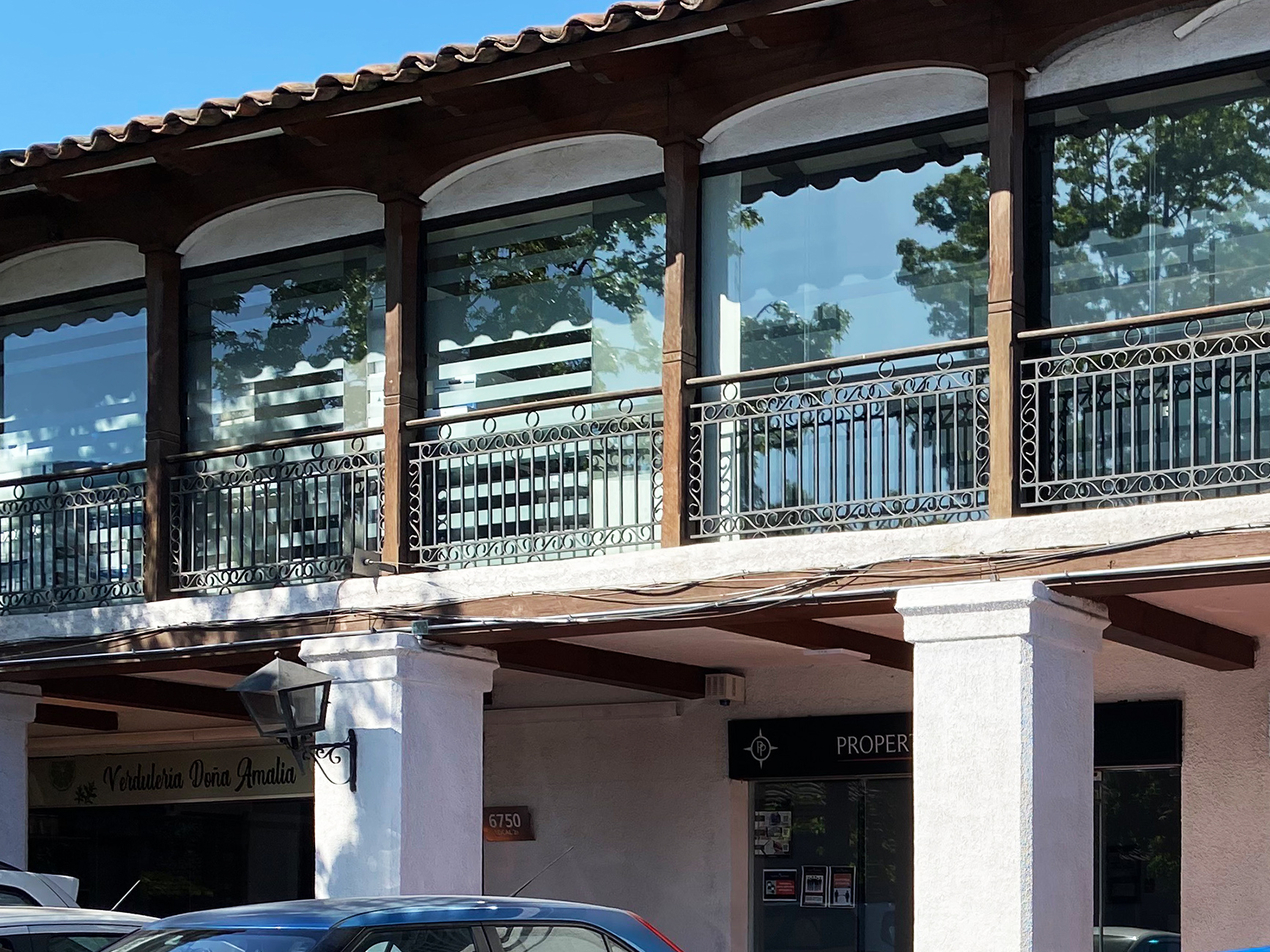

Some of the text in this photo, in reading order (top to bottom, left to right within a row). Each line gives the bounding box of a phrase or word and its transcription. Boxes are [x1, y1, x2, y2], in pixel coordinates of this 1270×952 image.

[836, 733, 912, 755] PROPER
[189, 759, 232, 788] Doña
[235, 757, 297, 792] Amalia
[488, 812, 521, 828] 6750
